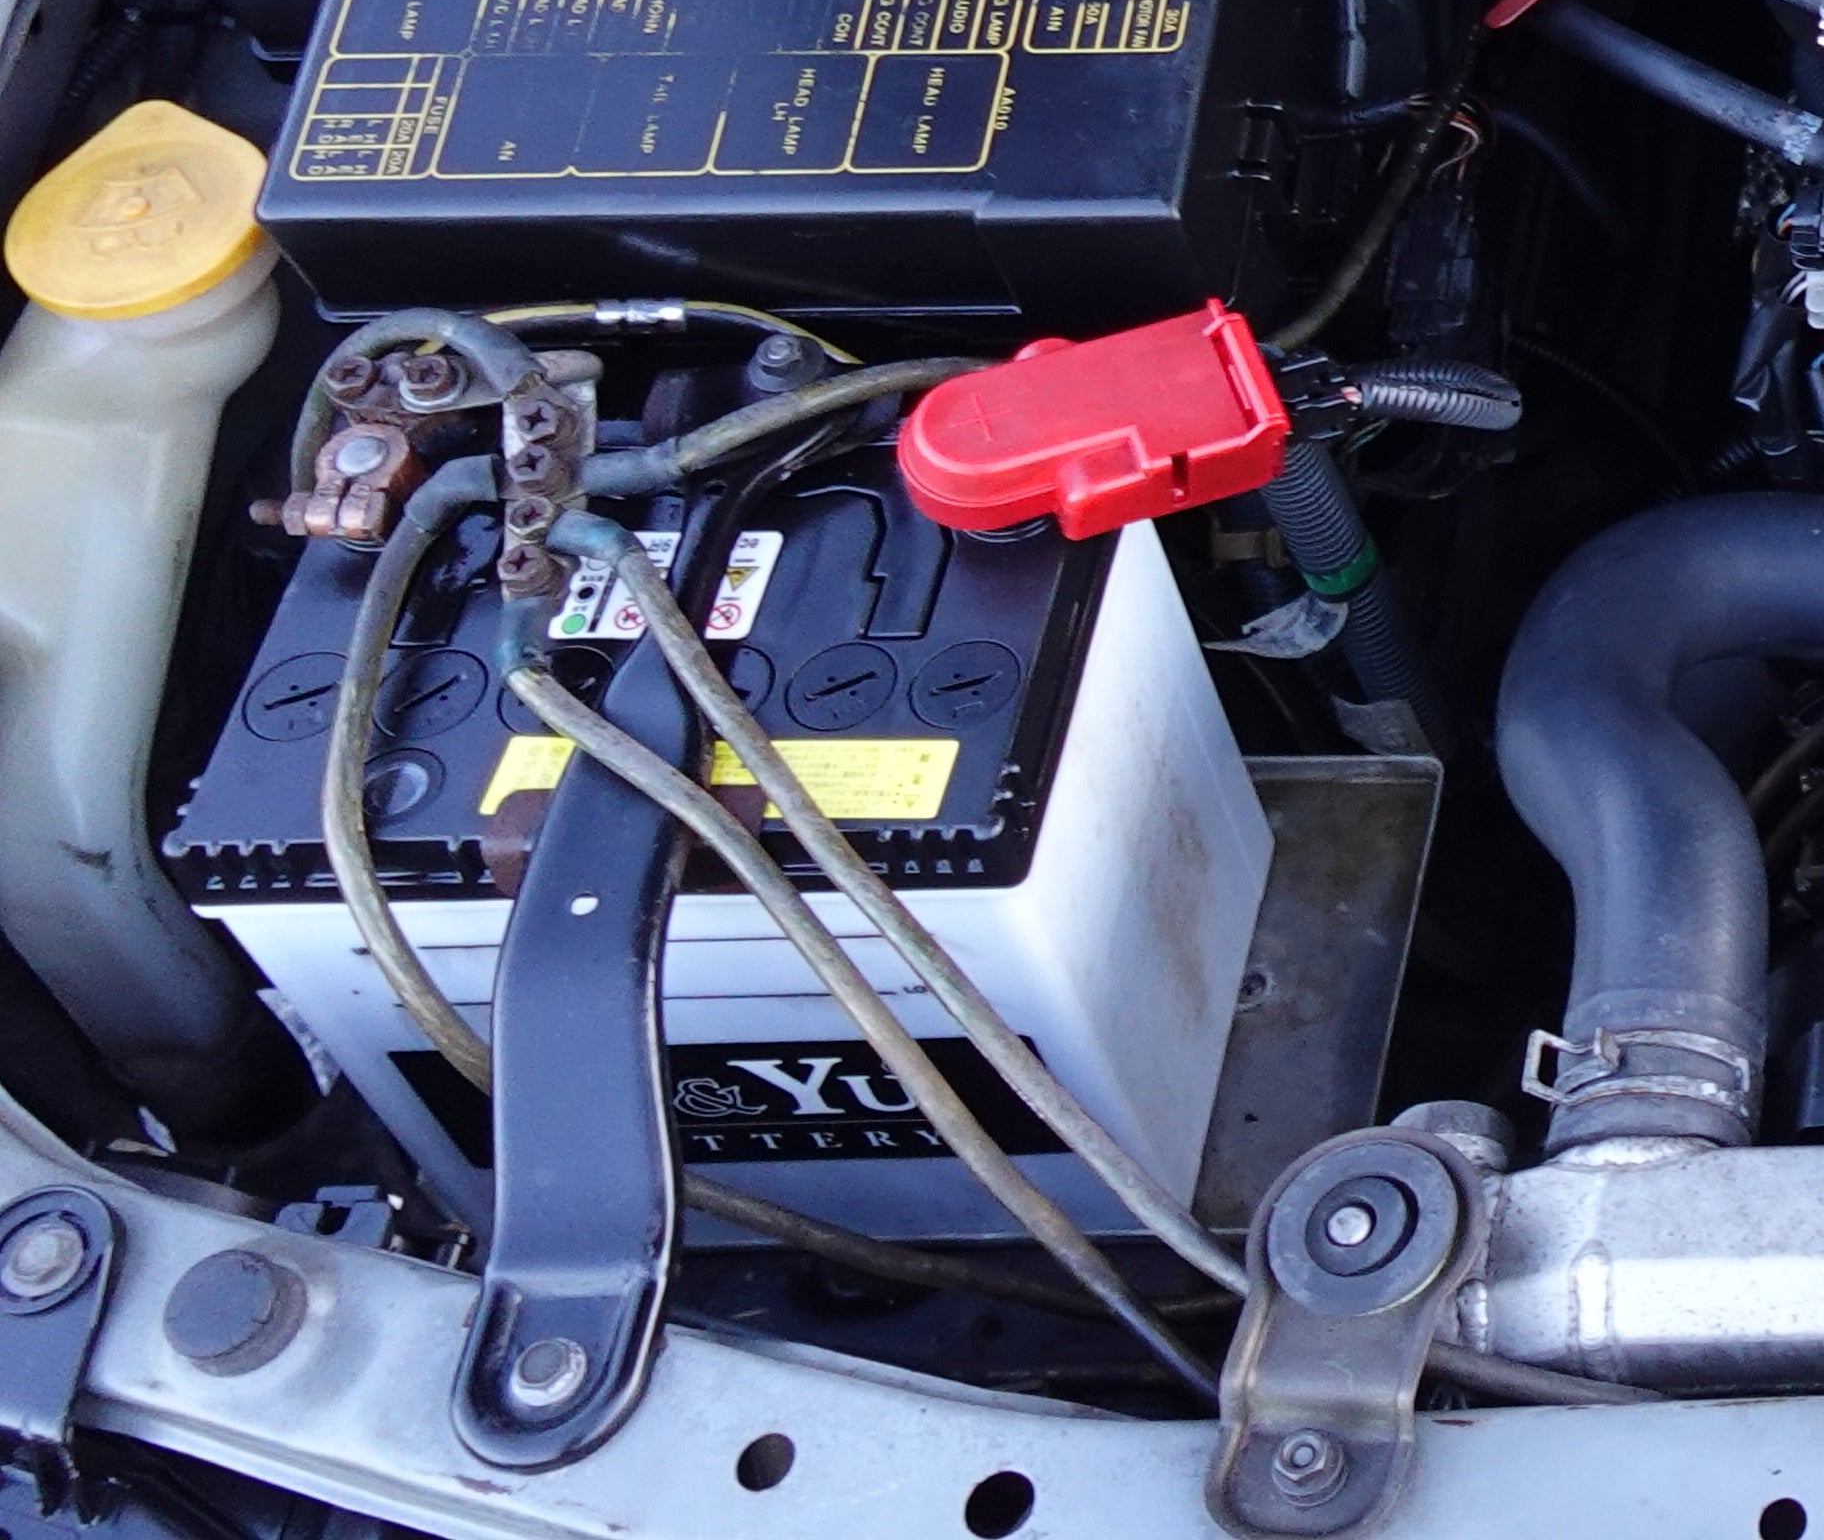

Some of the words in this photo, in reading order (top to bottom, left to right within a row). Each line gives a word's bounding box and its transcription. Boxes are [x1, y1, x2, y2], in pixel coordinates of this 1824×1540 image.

[398, 0, 423, 41] LAMP
[832, 13, 854, 44] CON
[870, 11, 893, 46] CONT
[909, 11, 931, 46] CONT
[986, 12, 1006, 46] LAMP
[793, 67, 817, 107] HEAD
[922, 67, 946, 107] HEAD
[397, 119, 416, 143] 20A
[423, 95, 448, 134] FUSE
[781, 116, 805, 156] LAMP
[911, 115, 934, 154] LAMP
[385, 150, 406, 175] 20A
[692, 1130, 943, 1152] TTERY
